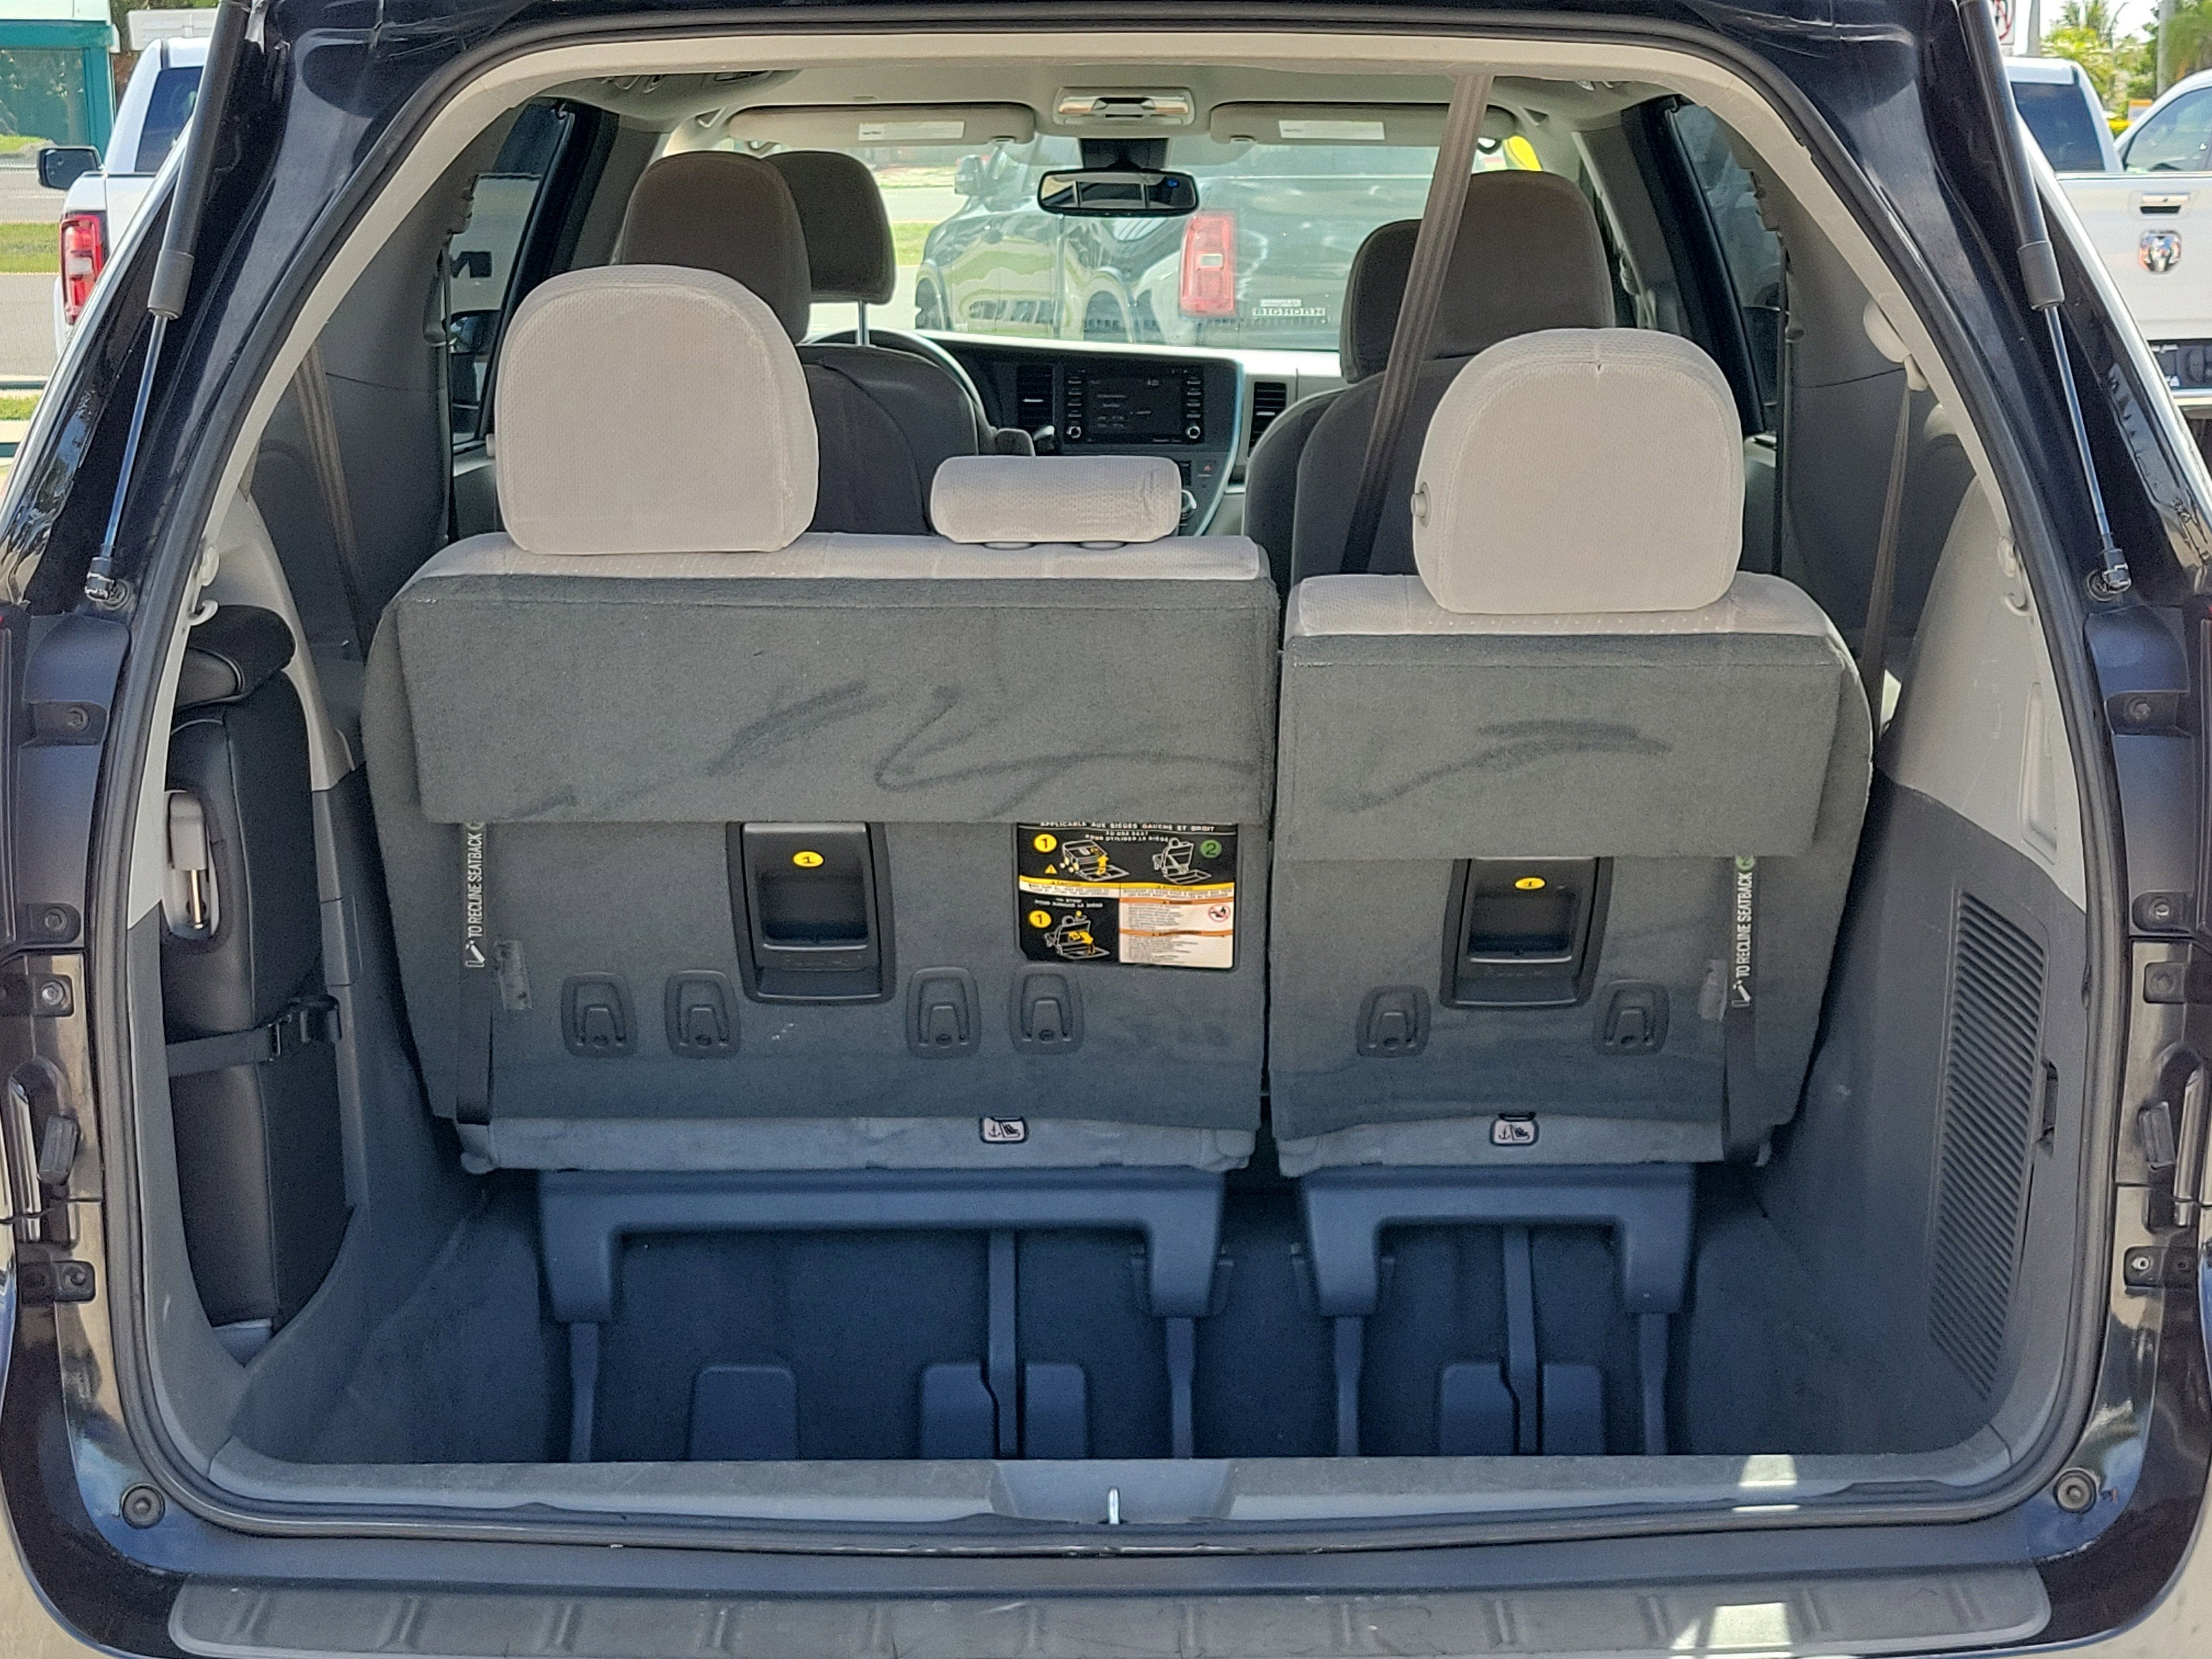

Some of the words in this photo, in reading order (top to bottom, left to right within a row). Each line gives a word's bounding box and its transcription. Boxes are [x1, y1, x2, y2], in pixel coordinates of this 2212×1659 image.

[467, 832, 483, 882] SEATBACK
[467, 883, 483, 924] RECLINE
[1737, 872, 1753, 922] SEATBACK
[467, 925, 483, 938] TO
[1736, 923, 1751, 964] RECLINE
[1735, 964, 1751, 978] TO
